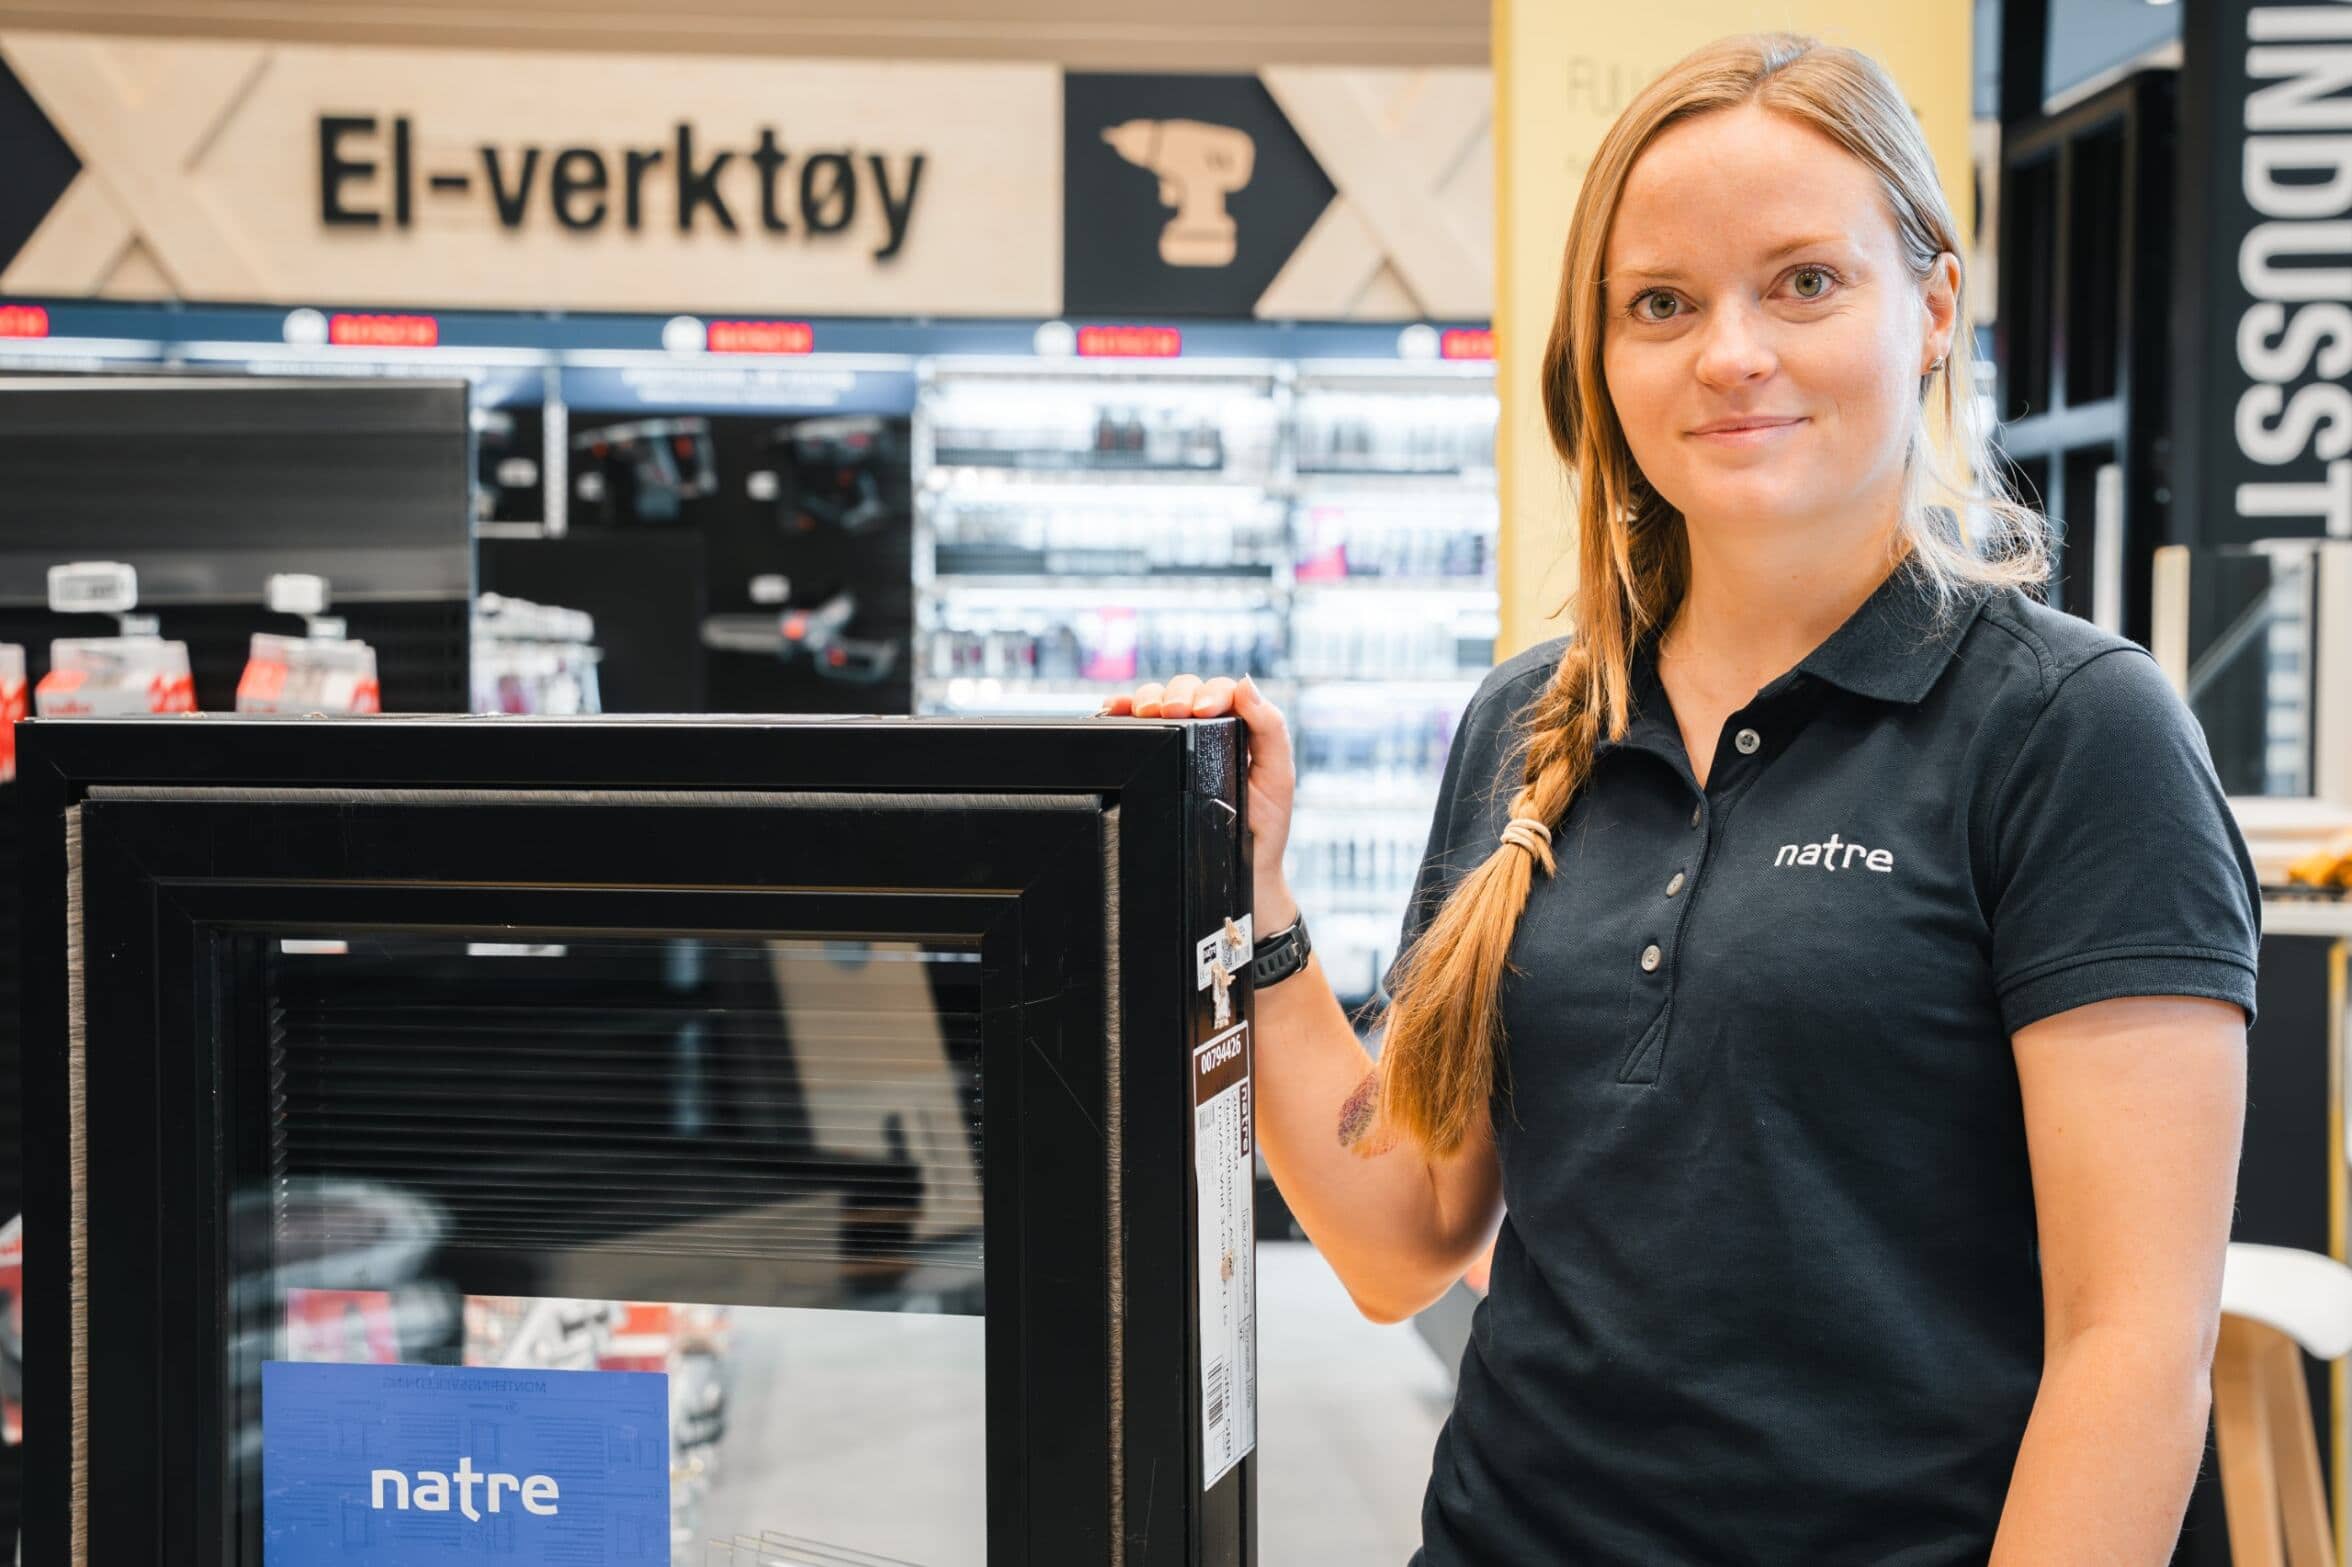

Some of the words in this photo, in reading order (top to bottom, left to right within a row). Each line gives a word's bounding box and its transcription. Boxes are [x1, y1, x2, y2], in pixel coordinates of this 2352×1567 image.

[317, 115, 926, 263] El-verktøy
[2236, 0, 2352, 537] INDUSST
[1774, 833, 1894, 872] natre
[1201, 1034, 1241, 1075] 00794426
[371, 1457, 560, 1522] natre
